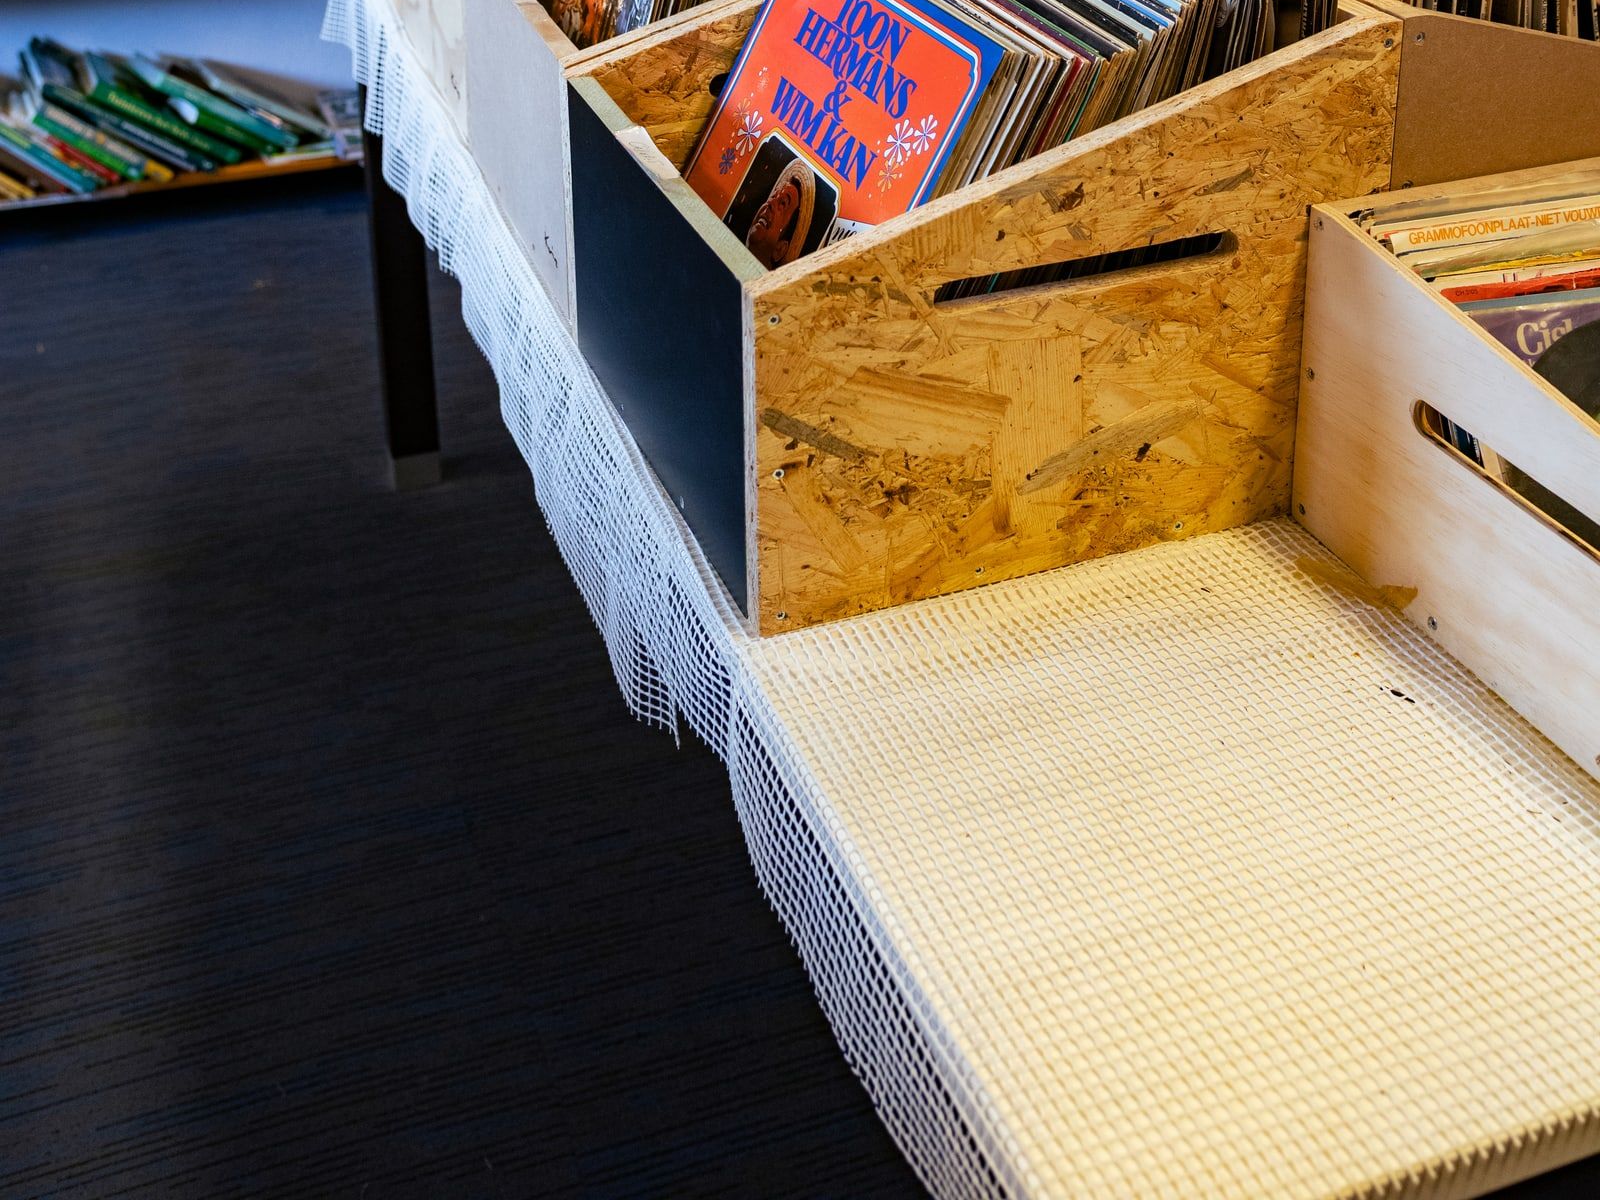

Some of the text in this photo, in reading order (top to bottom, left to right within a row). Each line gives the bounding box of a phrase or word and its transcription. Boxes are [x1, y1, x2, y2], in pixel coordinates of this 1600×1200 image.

[793, 8, 917, 119] HERMANS
[823, 80, 853, 122] &
[770, 76, 878, 192] WIM KAN
